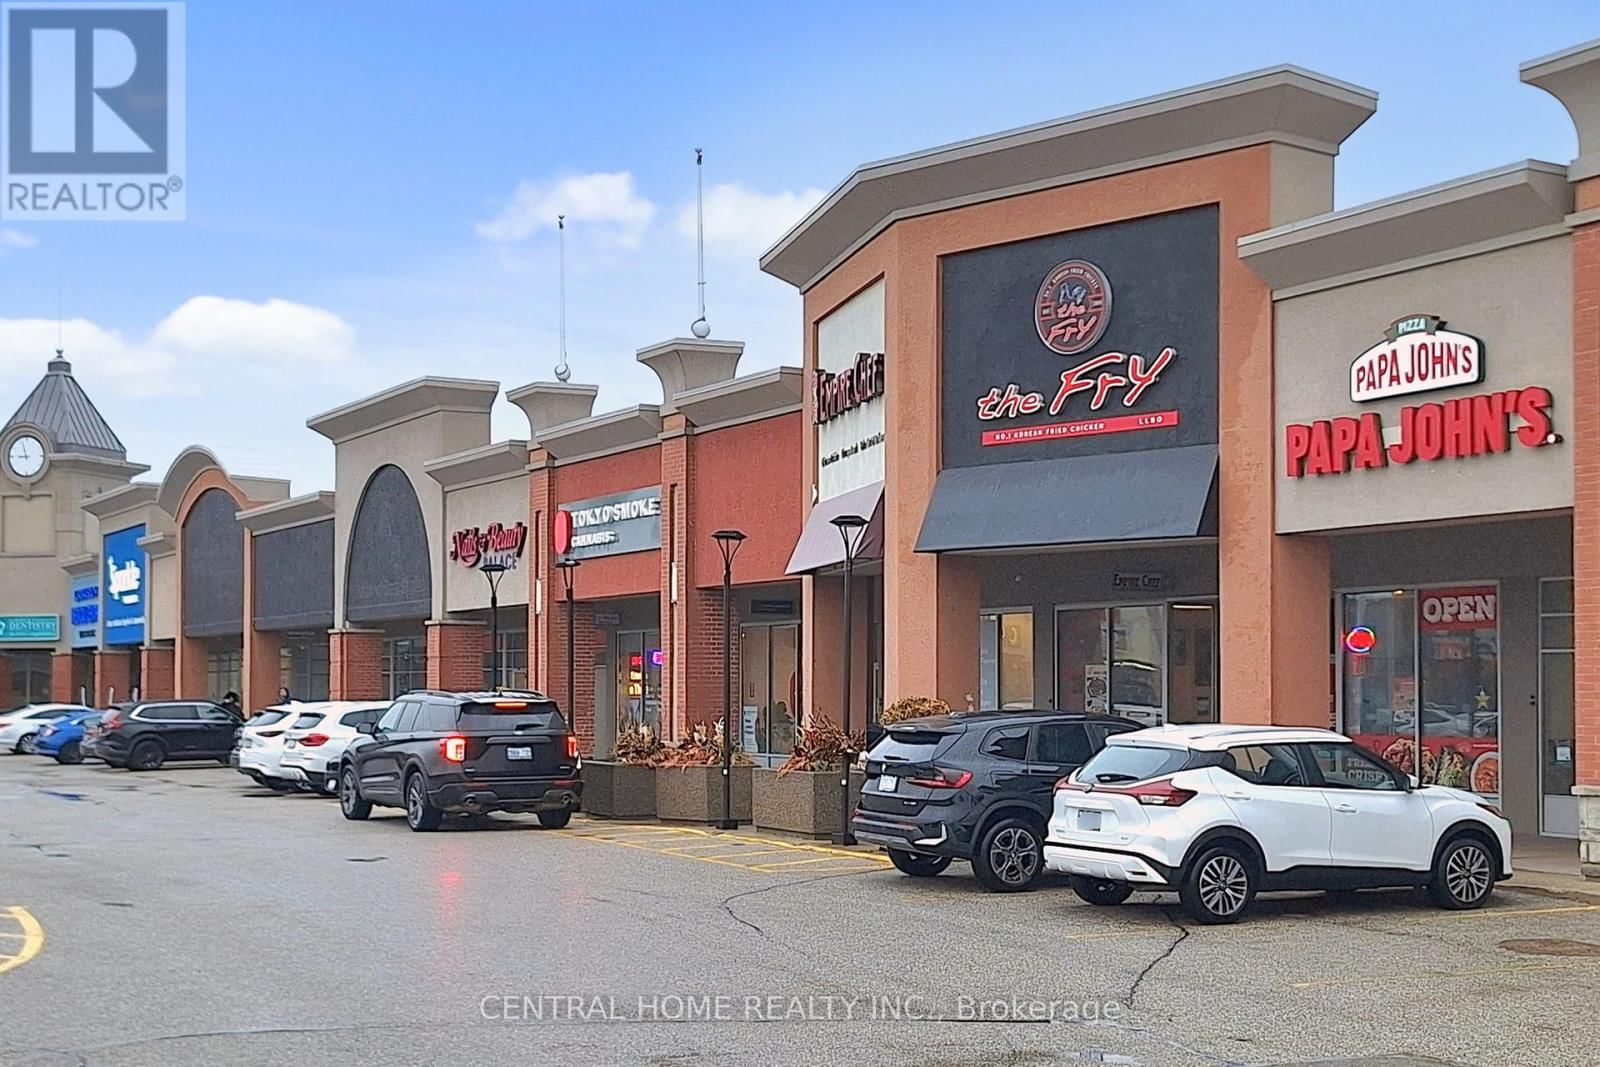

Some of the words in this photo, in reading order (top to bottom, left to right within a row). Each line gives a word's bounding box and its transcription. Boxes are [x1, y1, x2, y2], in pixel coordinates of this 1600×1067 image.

[1056, 302, 1087, 318] the
[1398, 318, 1427, 334] PIZZA
[1356, 349, 1401, 393] PAPA
[1405, 342, 1473, 383] JOHN'S
[977, 384, 1045, 420] the
[1045, 426, 1068, 436] FRIED
[1069, 422, 1105, 433] CHICKEN
[1286, 412, 1388, 479] PAPA
[1388, 386, 1554, 466] JOHN'S
[570, 505, 613, 529] TOKYO
[613, 497, 661, 521] SMOKE
[1422, 594, 1497, 624] OPEN
